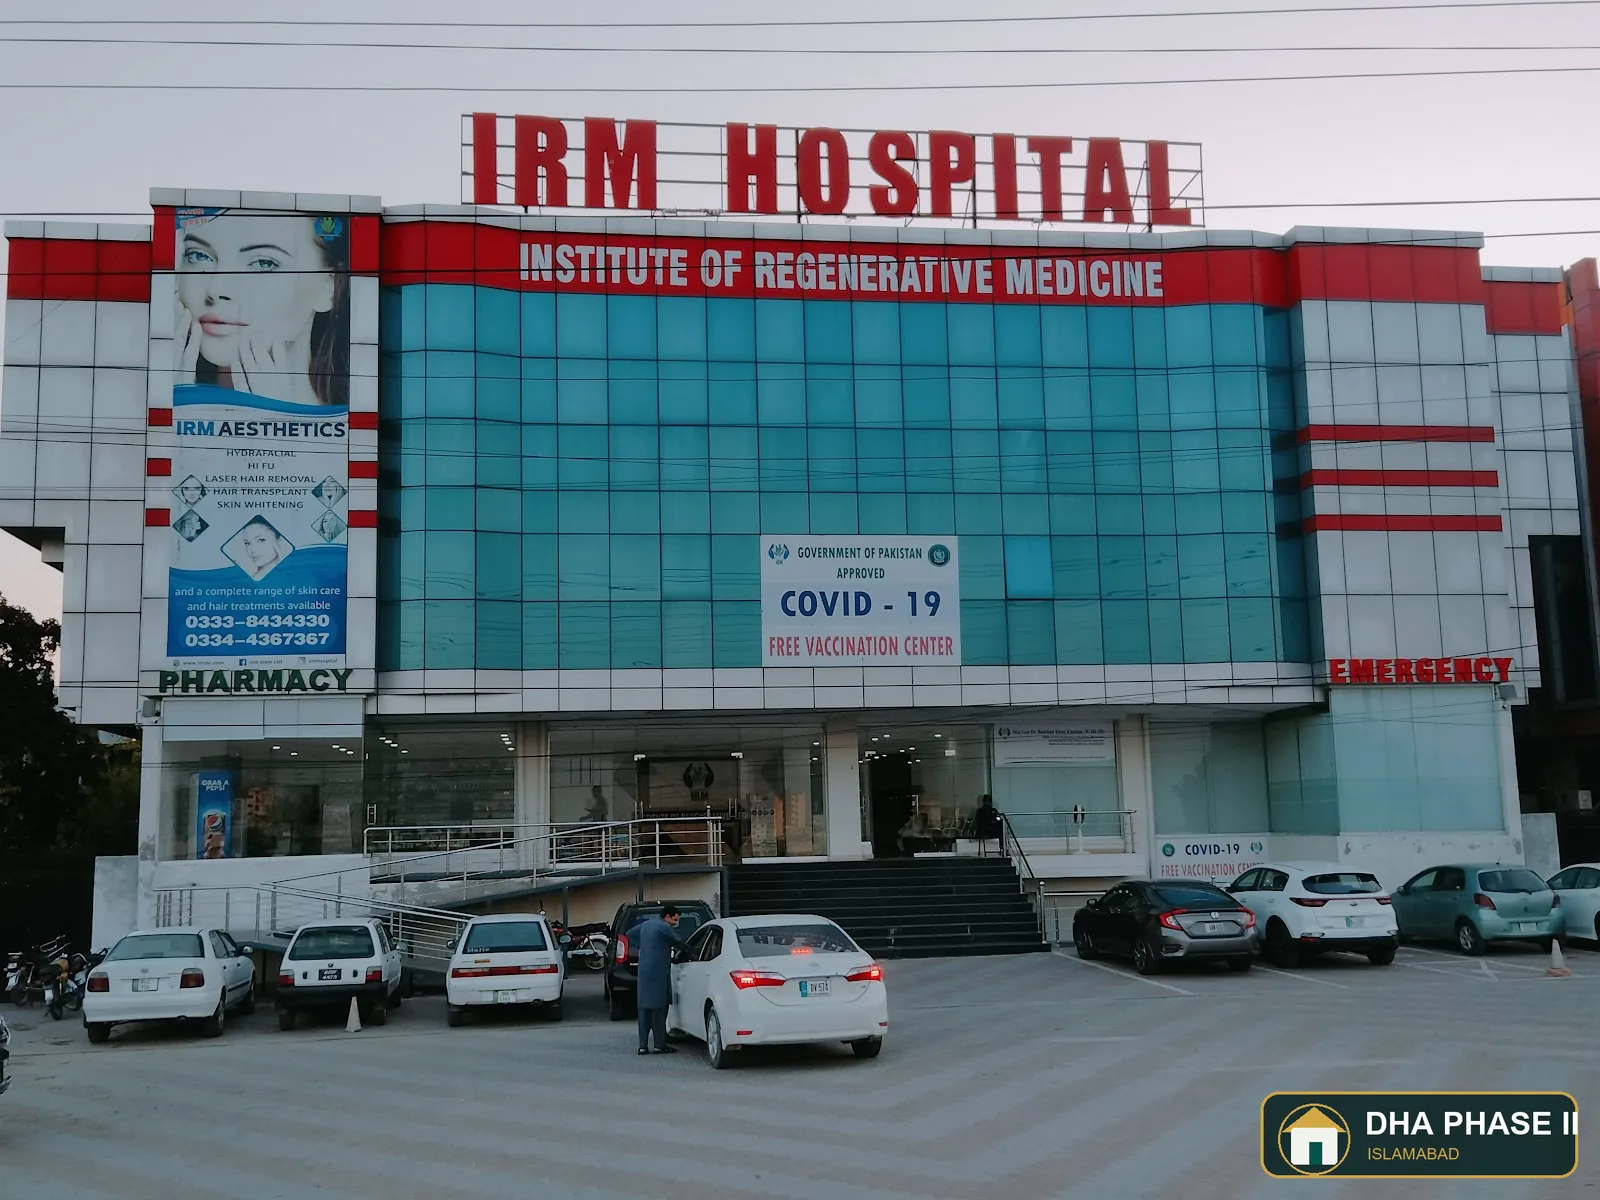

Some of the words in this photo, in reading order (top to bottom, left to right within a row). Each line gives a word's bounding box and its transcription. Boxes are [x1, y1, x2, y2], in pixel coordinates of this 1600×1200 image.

[473, 112, 657, 210] IRM
[726, 122, 1191, 225] HOSPITAL
[519, 243, 688, 287] INSTITUTE
[700, 248, 742, 288] OF
[754, 251, 993, 293] REGENERATIVE
[1005, 258, 1163, 297] MEDICINE
[176, 421, 214, 436] IRM
[218, 421, 346, 437] AESTHETICS
[226, 449, 296, 457] HYDRAFACIAL
[205, 475, 237, 483] LASER
[240, 475, 265, 483] HAIR
[268, 475, 316, 483] REMOVAL
[213, 488, 238, 496] HAIR
[241, 488, 308, 496] TRANSPLANT
[217, 501, 241, 509] SKIN
[244, 501, 304, 509] WHITENING
[797, 547, 861, 559] GOVERNMENT
[864, 547, 876, 559] OF
[878, 547, 922, 559] PAKISTAN
[836, 567, 885, 579] APPROVED
[175, 587, 194, 596] and
[205, 587, 252, 598] complete
[254, 588, 282, 598] range
[285, 586, 296, 595] of
[298, 586, 318, 595] skin
[320, 587, 341, 595] care
[187, 602, 206, 611] and
[209, 602, 228, 611] hair
[231, 601, 285, 610] treatments
[287, 600, 331, 610] available
[780, 590, 872, 617] COVID
[908, 590, 941, 617] 19
[185, 615, 330, 628] 0333-8434330
[185, 633, 330, 647] 0334-4367367
[769, 636, 800, 657] FREE
[805, 636, 898, 656] VACCINATION
[904, 636, 954, 656] CENTER
[1329, 657, 1513, 683] EMERGENCY
[159, 669, 353, 693] PHARMACY
[1185, 843, 1240, 855] COVID-19
[1161, 864, 1179, 877] FREE
[1181, 863, 1235, 876] VACCINATION
